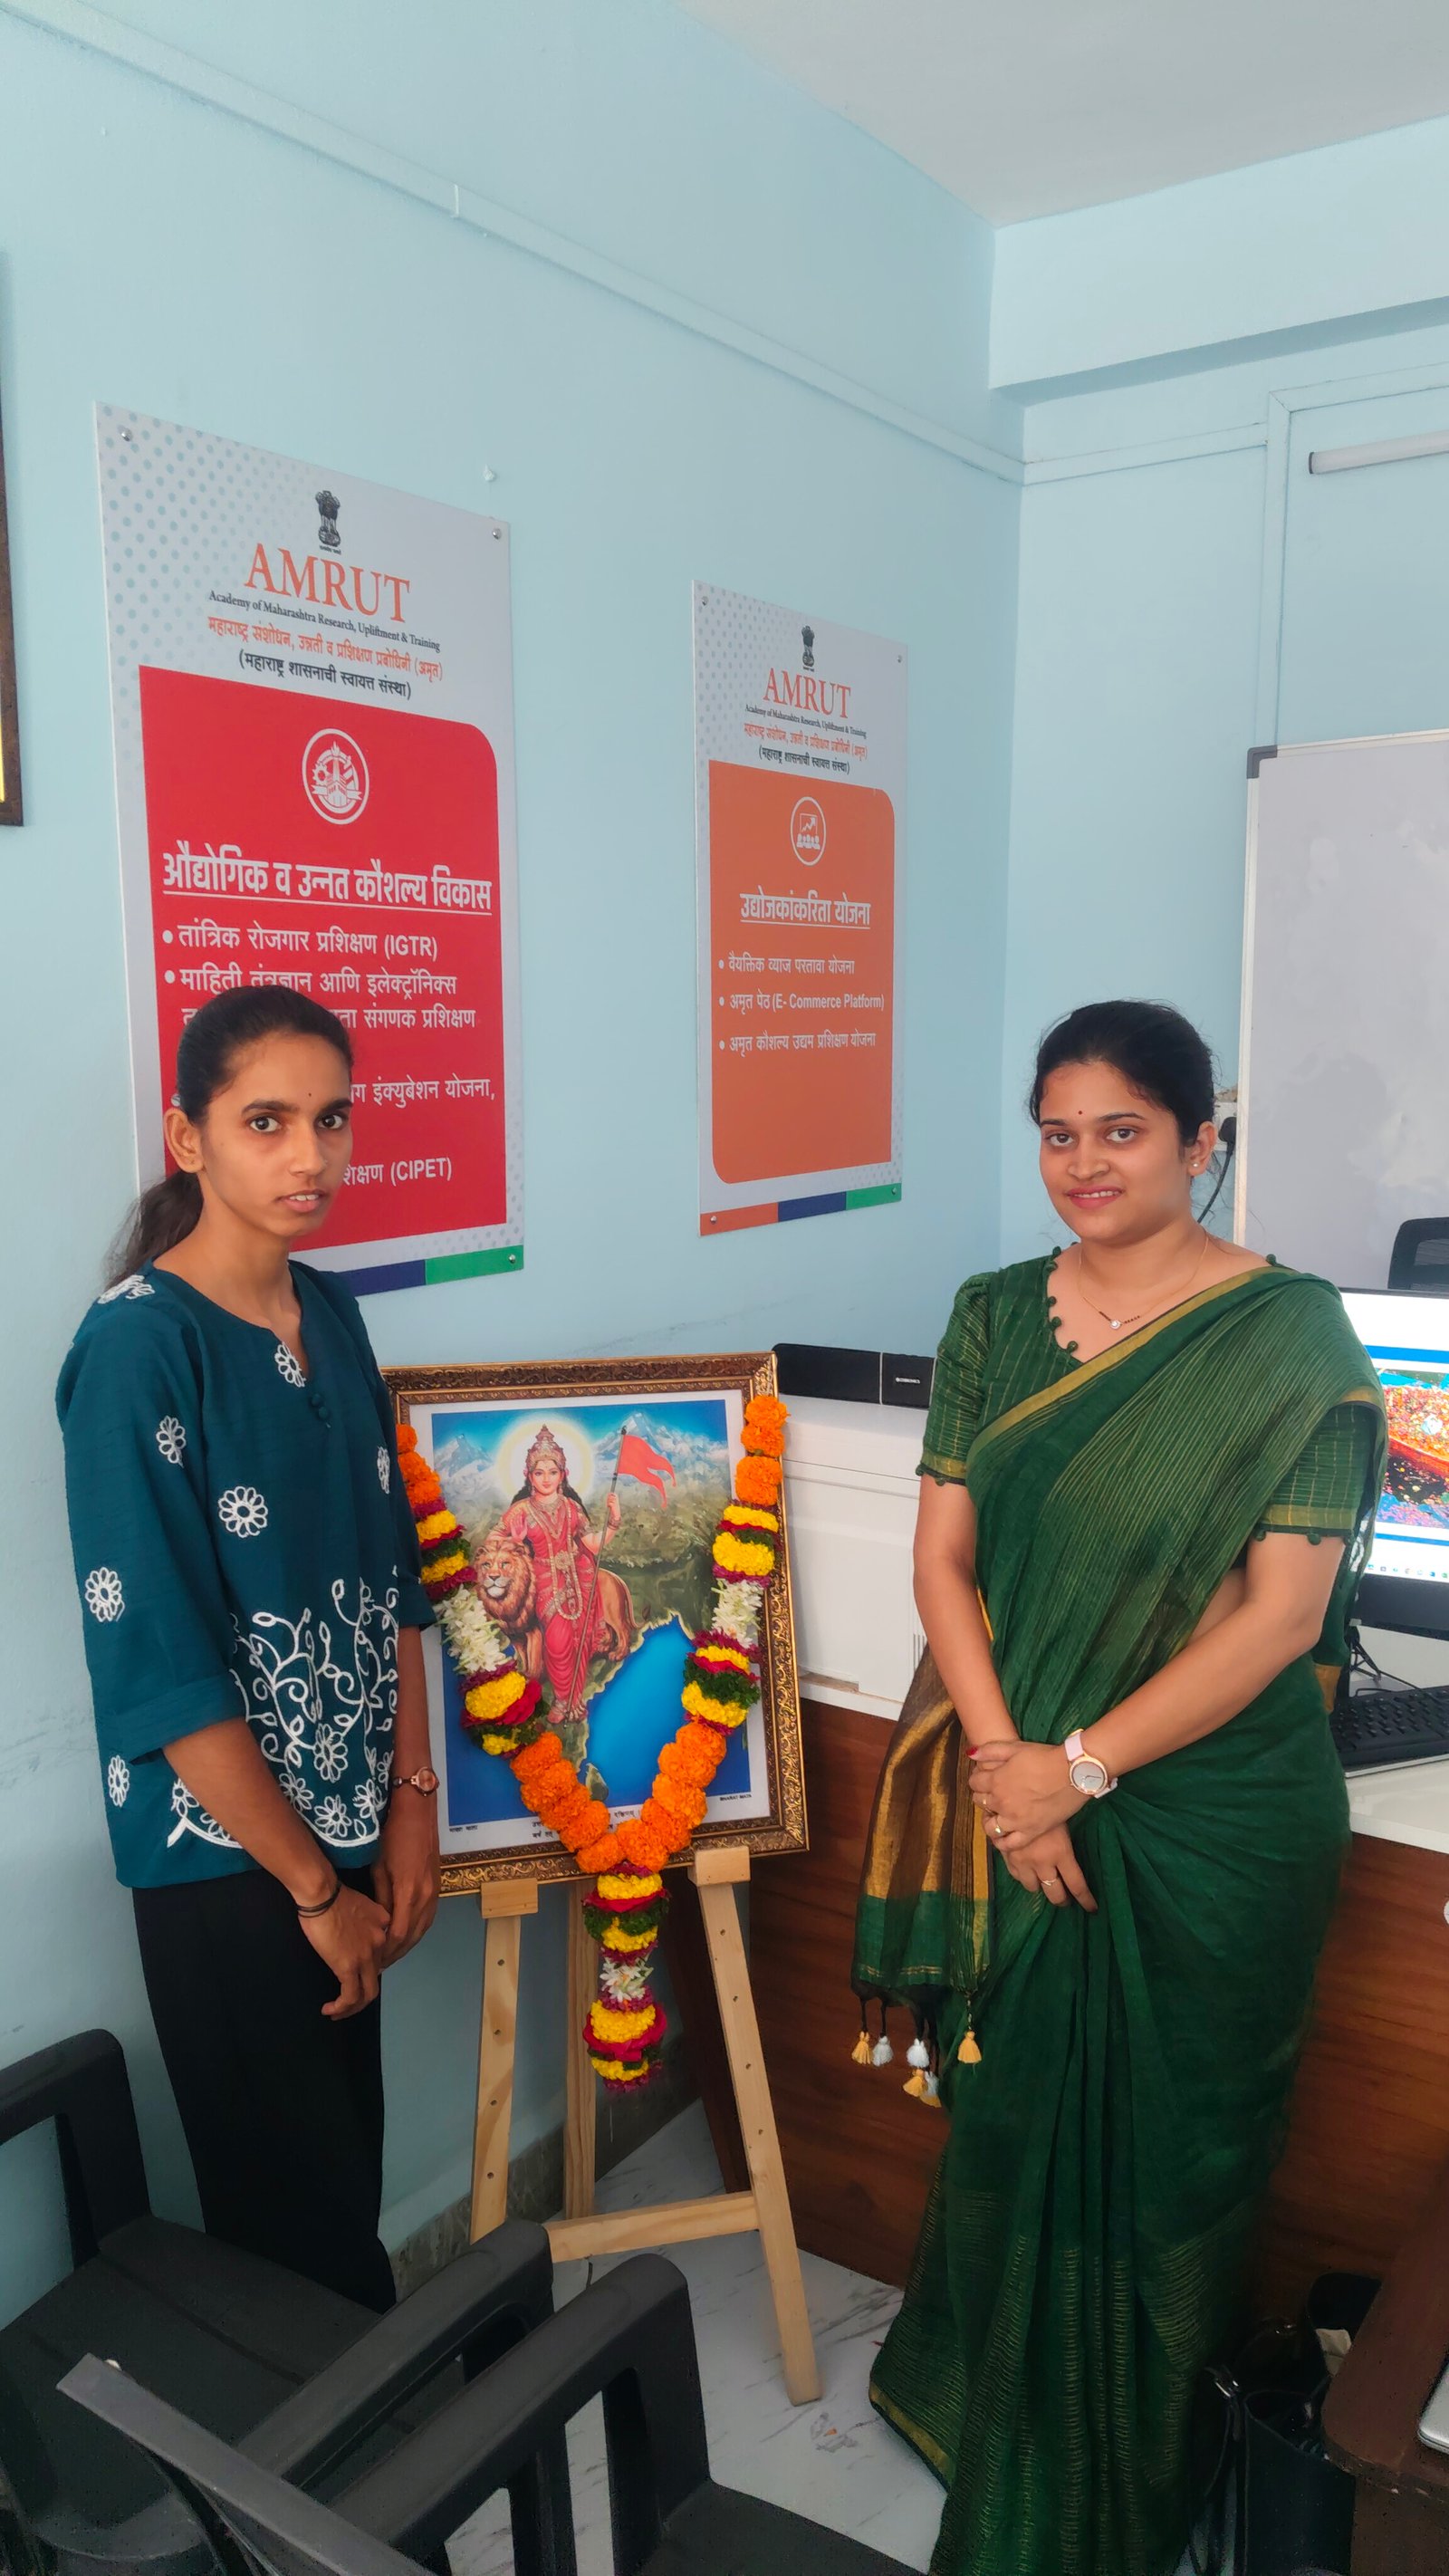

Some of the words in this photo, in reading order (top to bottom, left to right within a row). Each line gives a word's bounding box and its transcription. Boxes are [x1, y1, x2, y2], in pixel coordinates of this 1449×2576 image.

[244, 543, 410, 623] AMRUT
[209, 590, 251, 611] Academy
[253, 600, 263, 611] of
[264, 601, 316, 623] Maharashtra
[318, 613, 357, 633] Research,
[358, 622, 399, 641] Upliftment
[401, 633, 408, 643] &
[408, 634, 441, 653] Training
[208, 617, 249, 642] महाराष्ट्र
[252, 620, 295, 651] संशोधन,
[298, 632, 323, 654] उन्नती
[326, 640, 333, 655] व
[337, 639, 373, 665] प्रशिक्षण
[376, 648, 411, 672] प्रबोधिनी
[415, 658, 443, 683] (अमृत)
[239, 649, 284, 678] (महाराष्ट्र
[288, 660, 337, 683] शासनाची
[341, 671, 375, 691] स्वायत्त
[379, 674, 411, 700] संस्था)
[763, 668, 851, 719] AMRUT
[745, 704, 766, 717] Academy
[772, 709, 800, 724] Maharashtra
[162, 839, 269, 894] औद्योगिक
[273, 861, 293, 897] व
[295, 863, 350, 900] उन्नत
[353, 858, 428, 906] कौशल्य
[431, 864, 493, 910] विकास
[739, 885, 831, 924] उद्योजकांकरिता
[834, 891, 871, 926] योजना
[177, 917, 241, 948] तांत्रिक
[246, 919, 311, 952] रोजगार
[316, 925, 378, 954] प्रशिक्षण
[384, 934, 438, 962] (IGTR)
[179, 961, 243, 995] माहिती
[319, 966, 360, 994] आणि
[366, 966, 457, 1001] इलेक्ट्रॉनिक्स
[728, 950, 764, 973] वैयक्तिक
[768, 957, 792, 974] व्याज
[795, 958, 825, 975] परतावा
[828, 955, 855, 975] योजना
[363, 1002, 417, 1029] संगणक
[421, 1003, 476, 1029] प्रशिक्षण
[730, 994, 753, 1014] अमृत
[756, 988, 771, 1010] पेठ
[789, 994, 841, 1009] Commerce
[844, 993, 885, 1012] Platform)
[729, 1036, 753, 1058] अमृत
[756, 1030, 790, 1051] कौशल्य
[792, 1034, 814, 1050] उद्यम
[817, 1028, 849, 1049] प्रशिक्षण
[849, 1027, 877, 1047] योजना
[372, 1073, 440, 1109] इंक्युबेशन
[445, 1072, 495, 1101] योजना,
[390, 1157, 452, 1187] (CIPET)
